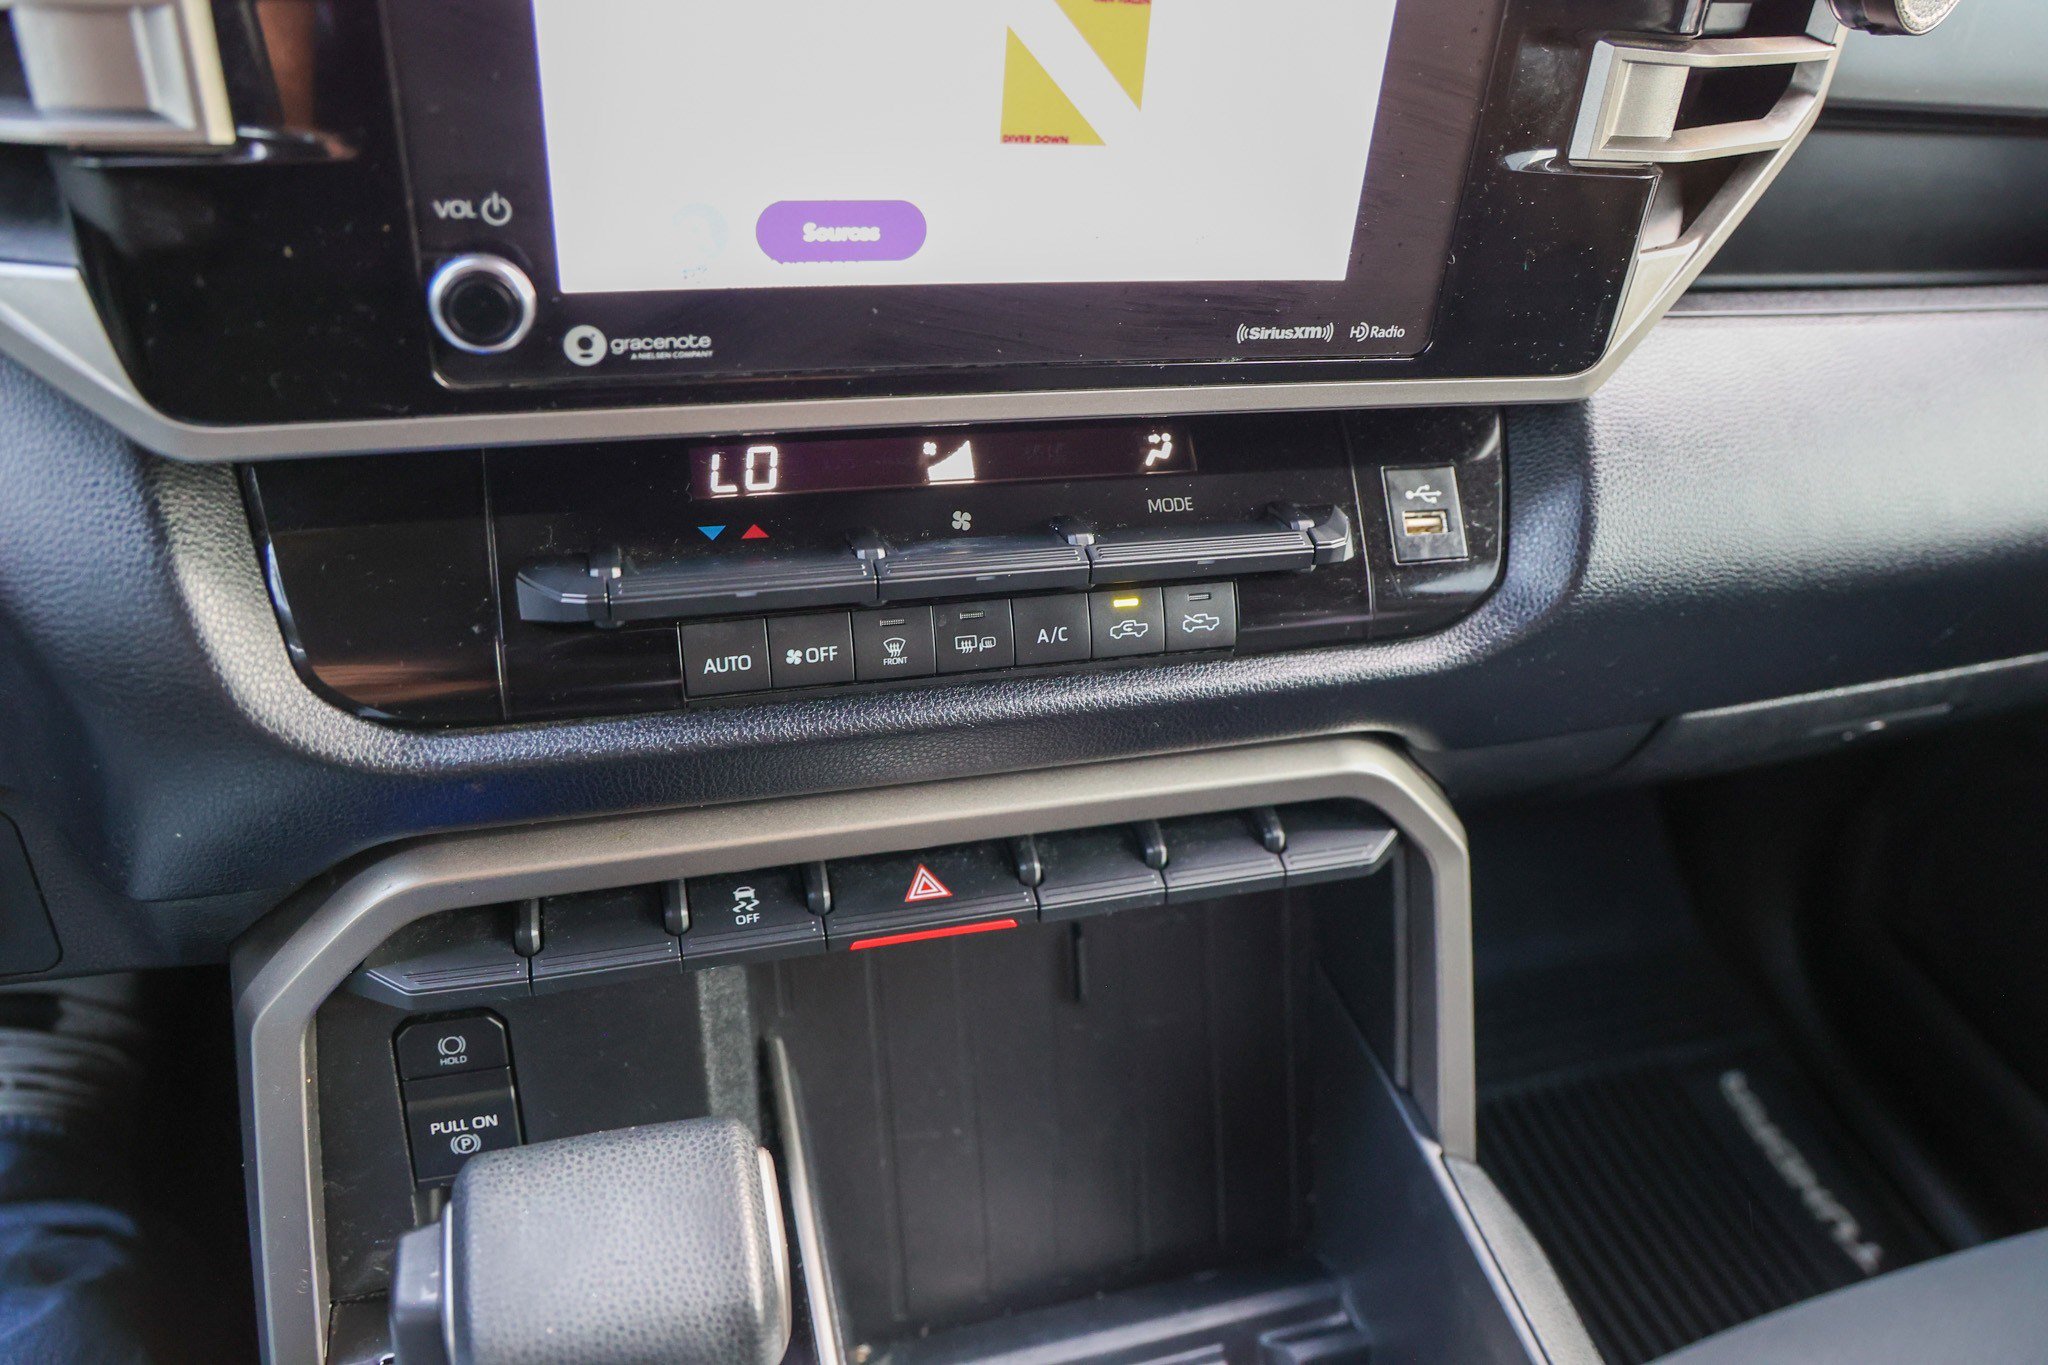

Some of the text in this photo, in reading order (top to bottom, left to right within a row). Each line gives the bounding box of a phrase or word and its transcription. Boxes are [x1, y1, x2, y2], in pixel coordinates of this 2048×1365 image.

[1035, 134, 1069, 144] DOWN
[433, 199, 477, 219] VOL
[802, 221, 881, 243] Sources
[1370, 324, 1406, 339] Radio
[610, 334, 712, 355] gracenote
[630, 352, 638, 360] A
[672, 350, 714, 359] COMPANY
[1148, 496, 1194, 513] MODE
[1037, 626, 1069, 644] A/C
[805, 645, 838, 664] OFF
[883, 656, 908, 666] FRONT
[703, 654, 752, 675] AUTO
[735, 912, 760, 926] OFF
[440, 1055, 468, 1066] HOLD
[430, 1113, 499, 1136] PULL ON
